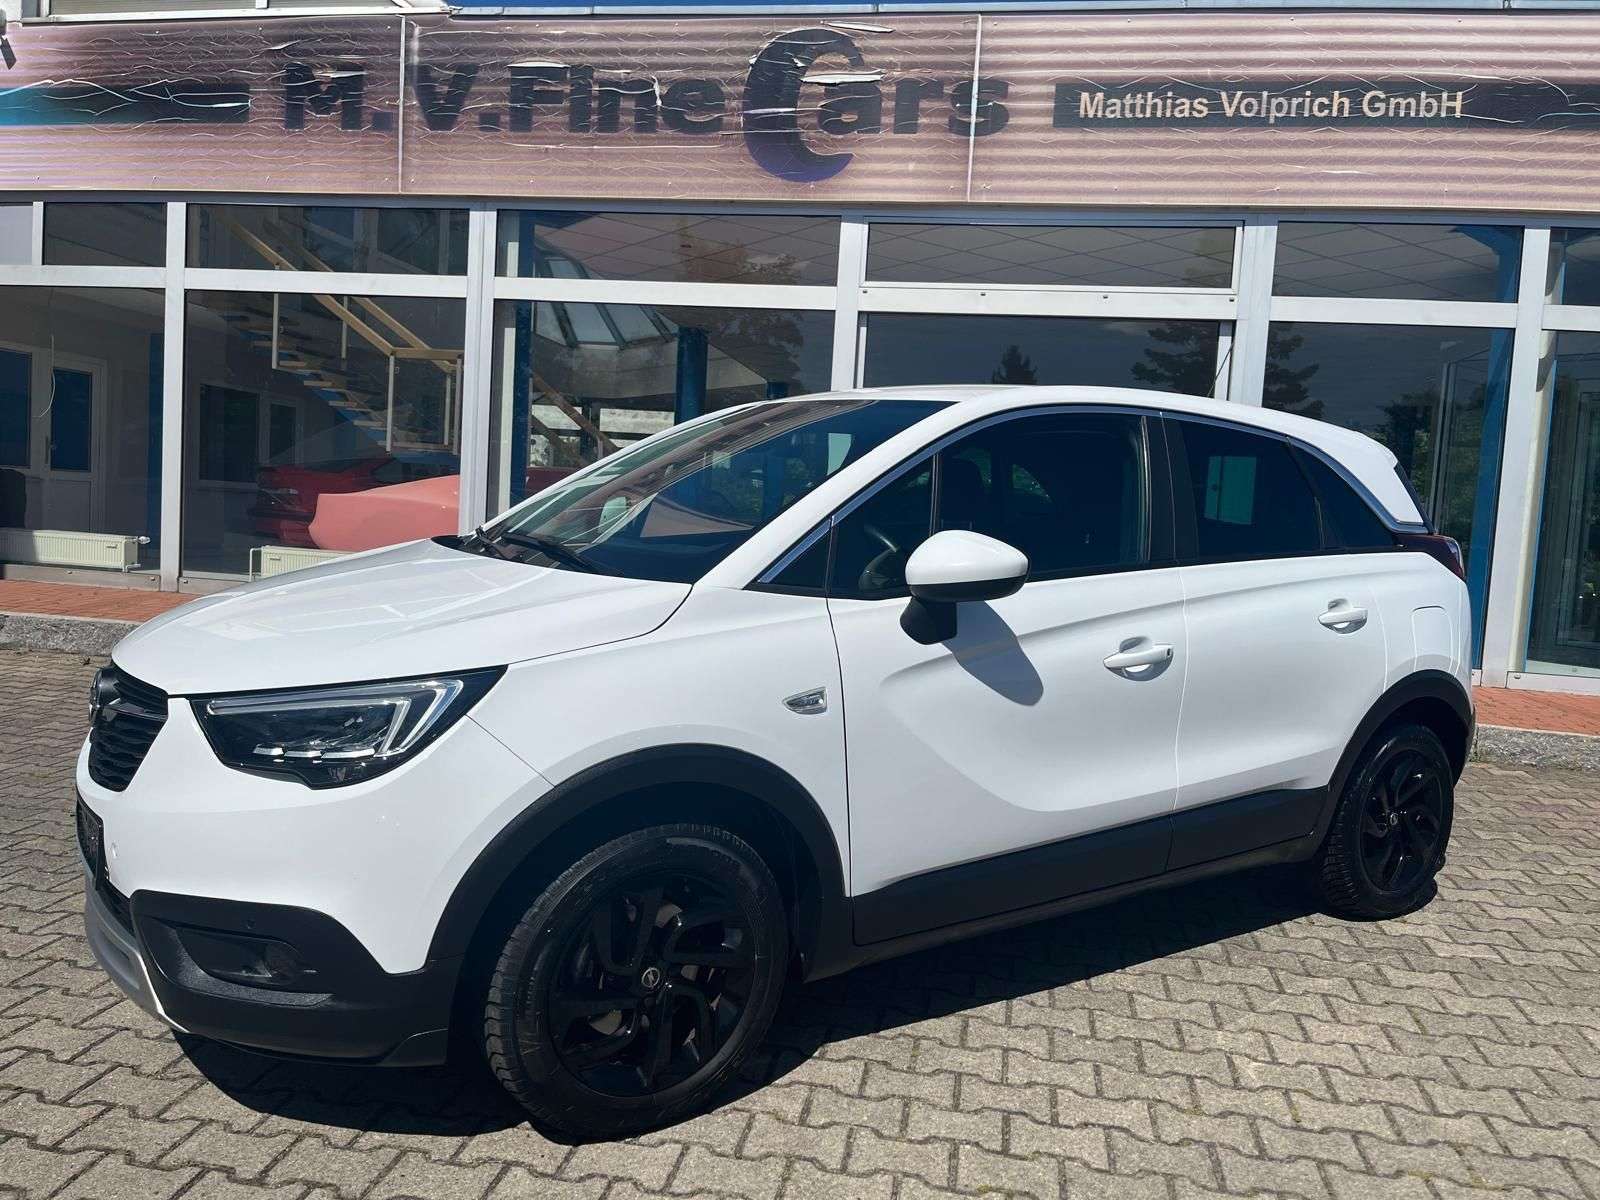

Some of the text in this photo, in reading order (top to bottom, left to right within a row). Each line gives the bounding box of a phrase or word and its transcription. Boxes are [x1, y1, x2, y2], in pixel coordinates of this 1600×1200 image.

[1078, 89, 1465, 125] Matthias Volprich GmbH
